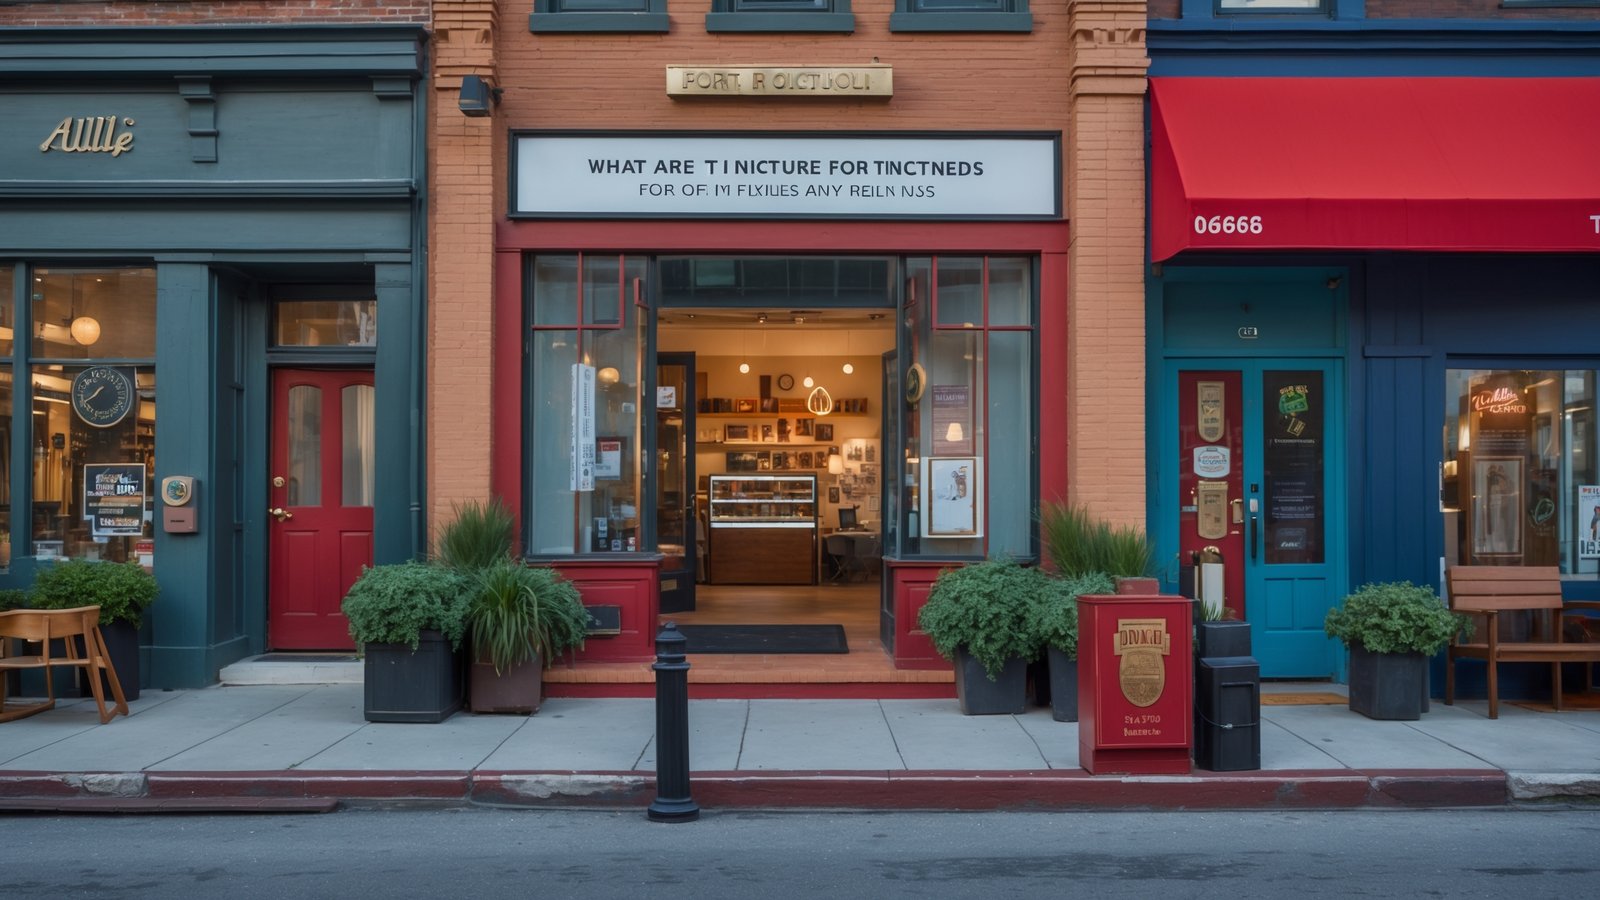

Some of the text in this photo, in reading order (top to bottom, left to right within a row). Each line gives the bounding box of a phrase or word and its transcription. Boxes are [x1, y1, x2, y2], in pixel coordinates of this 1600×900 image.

[588, 159, 646, 174] WHAT
[653, 159, 695, 174] ARE
[829, 160, 869, 175] FOR
[873, 160, 984, 176] TINCTNEDS
[639, 183, 675, 196] FOR
[805, 184, 843, 197] ANY
